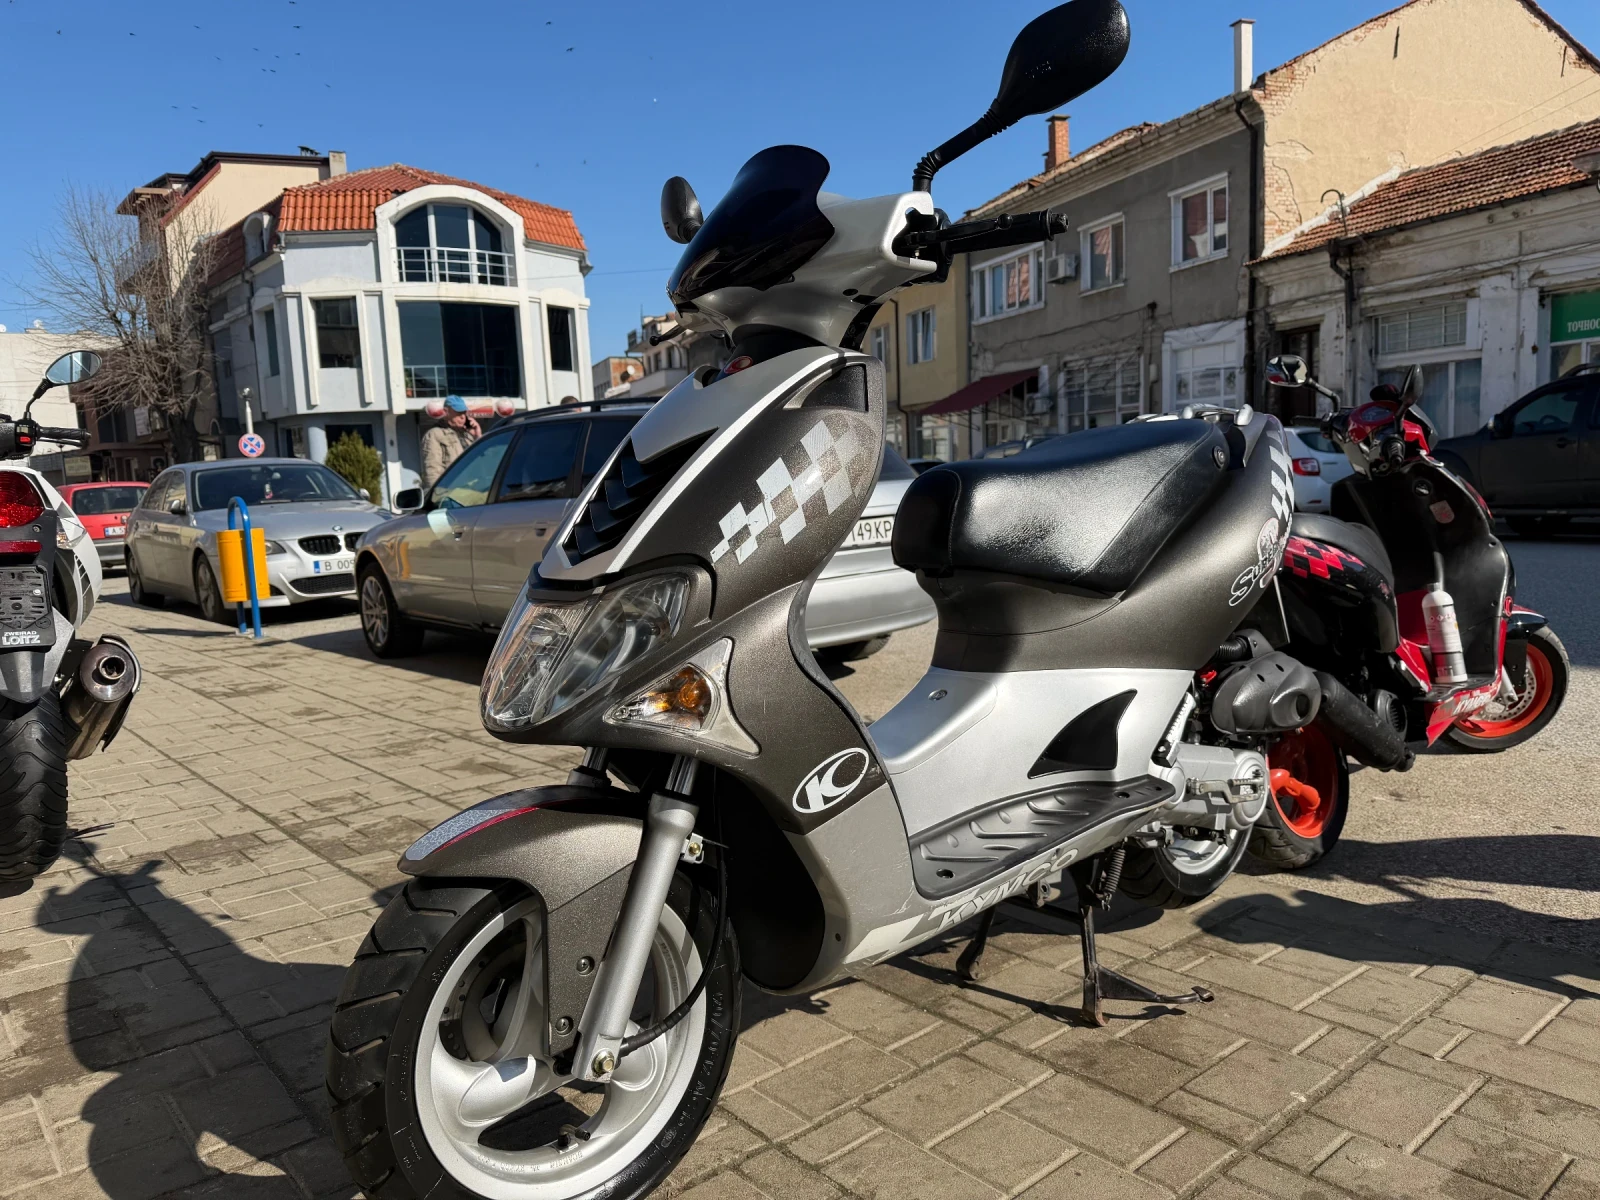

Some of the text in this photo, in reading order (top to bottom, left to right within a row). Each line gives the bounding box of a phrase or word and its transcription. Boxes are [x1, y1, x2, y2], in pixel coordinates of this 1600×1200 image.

[324, 561, 332, 571] B
[2, 634, 41, 646] LOITZ
[935, 848, 1079, 933] KYMCO
